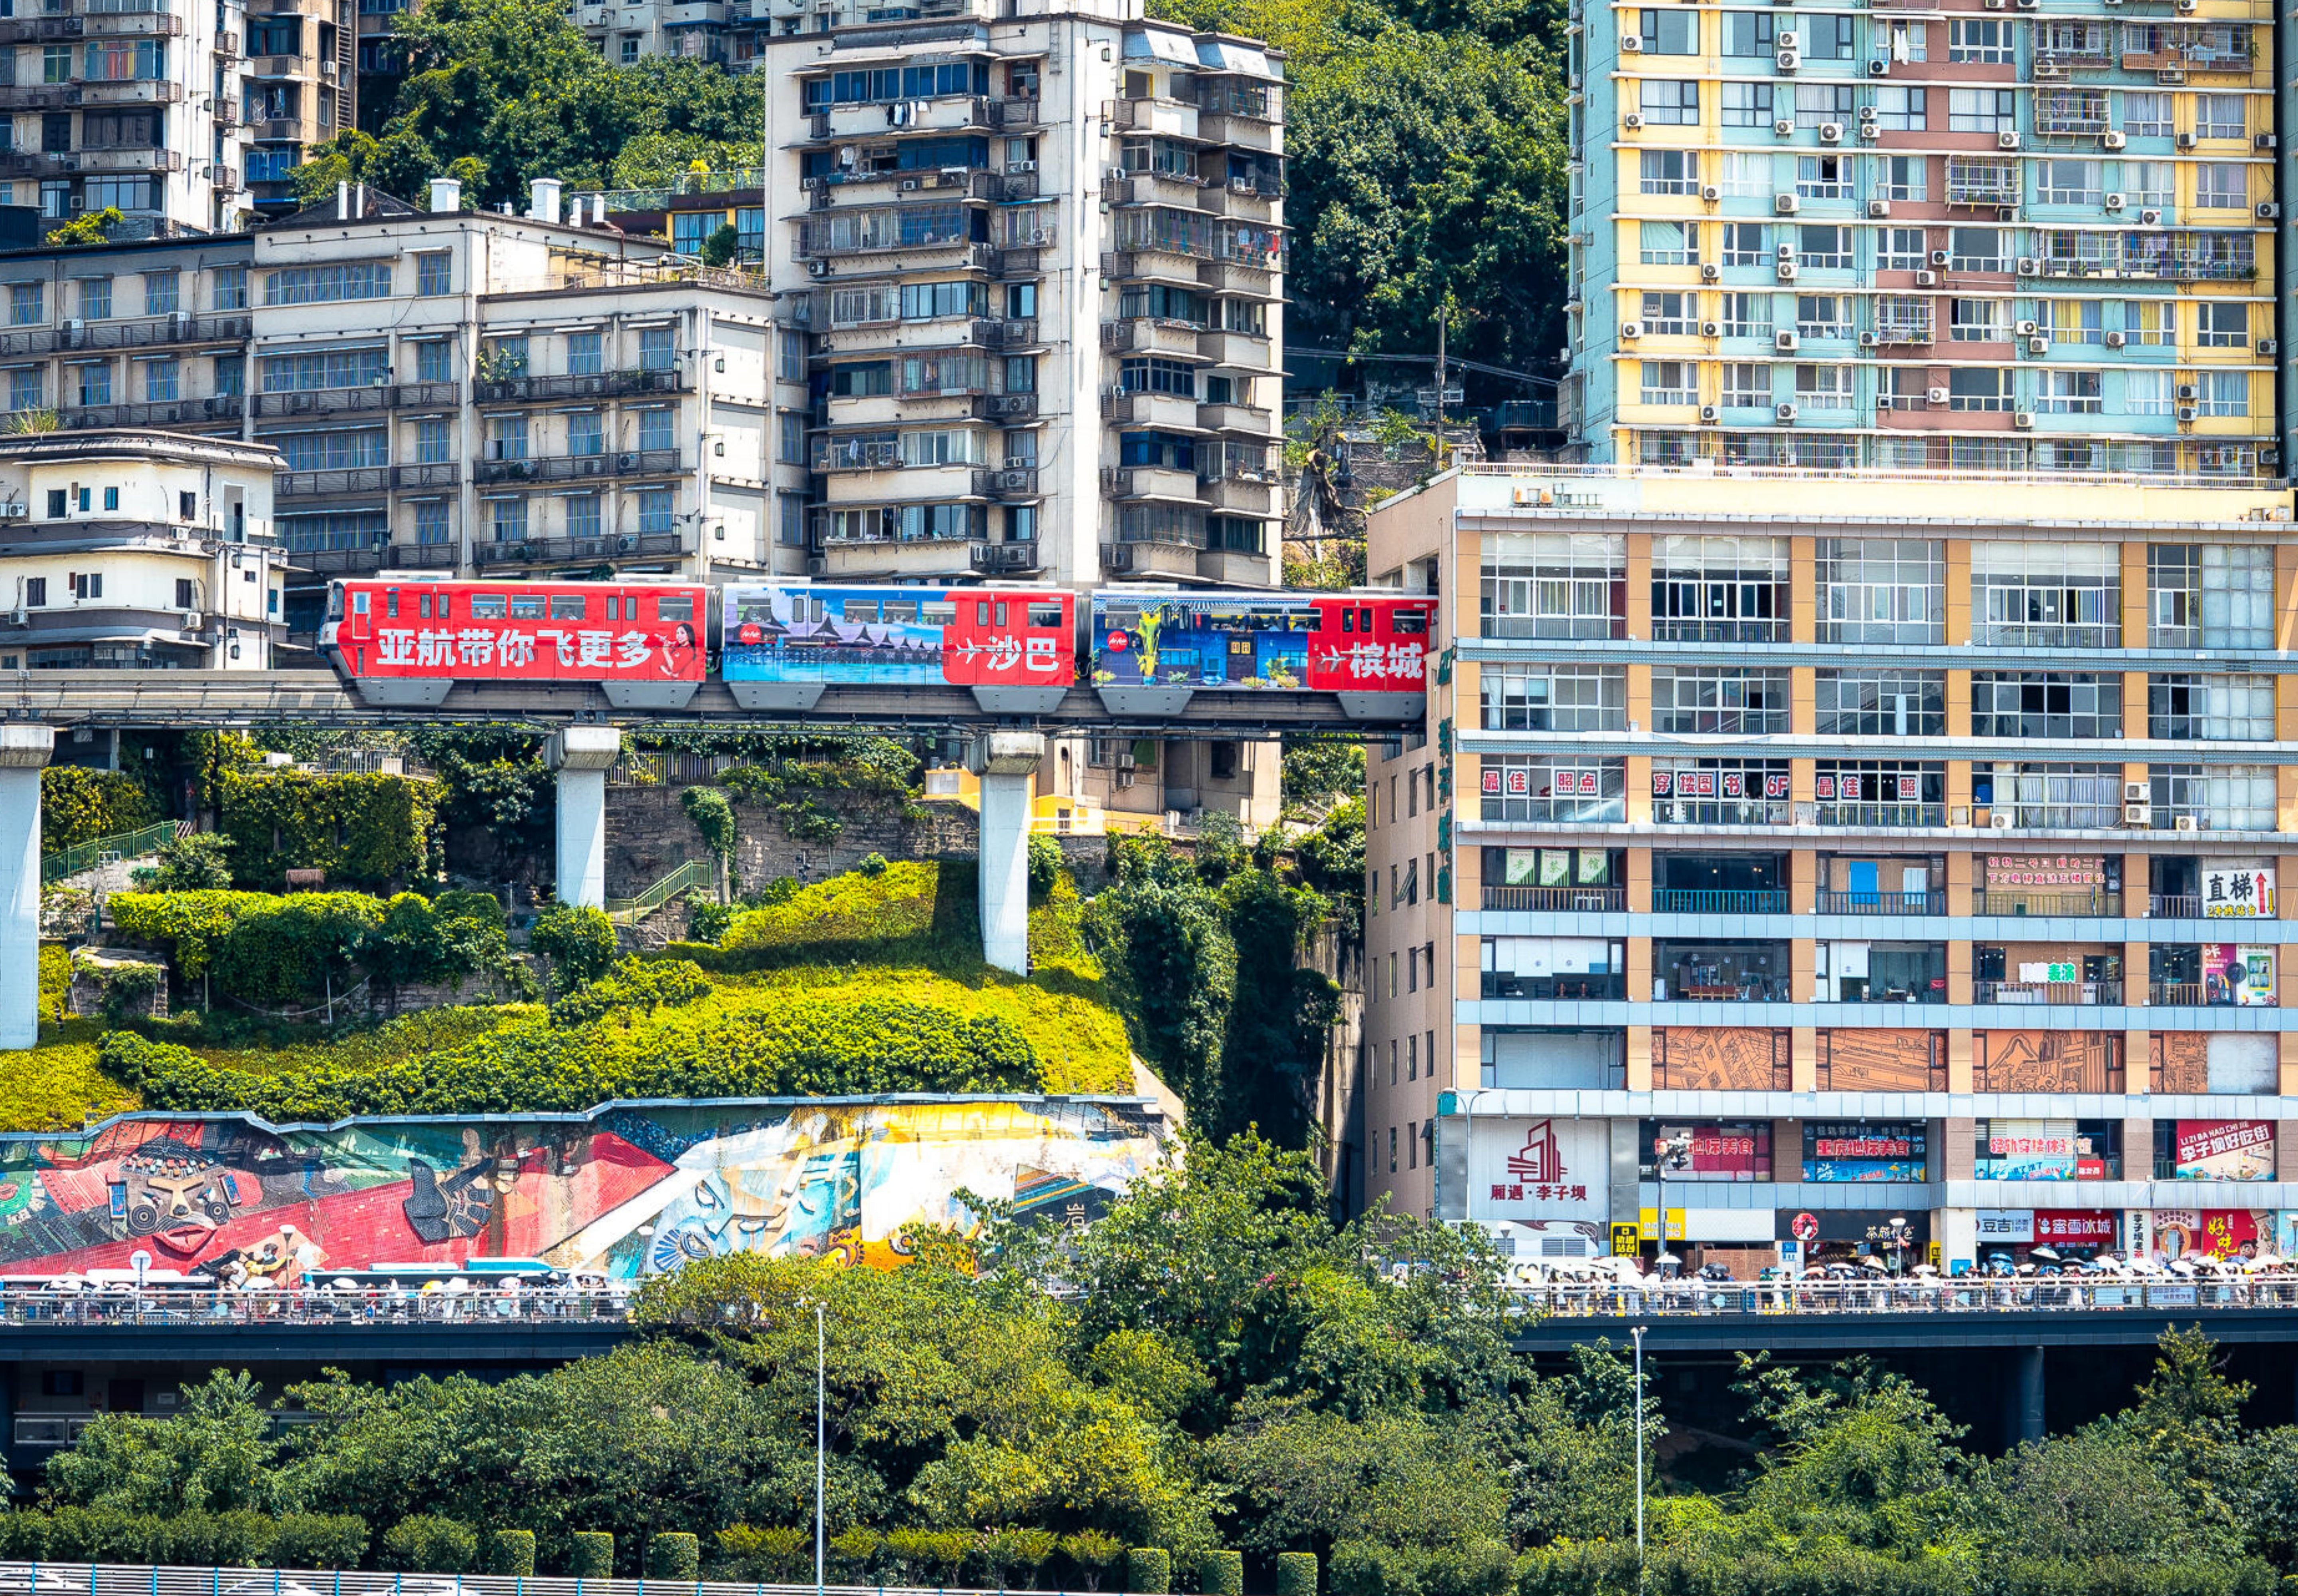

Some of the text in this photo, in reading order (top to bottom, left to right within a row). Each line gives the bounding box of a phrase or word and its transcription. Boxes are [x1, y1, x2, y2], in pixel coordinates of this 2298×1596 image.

[377, 629, 653, 668] 亚航带你飞更多
[986, 635, 1060, 672] 沙巴
[1349, 642, 1423, 679] 槟城
[1483, 770, 1527, 792] 最佳
[1653, 773, 1789, 796] 穿楼图书 6F
[1817, 774, 1860, 798] 最佳
[2206, 872, 2253, 902] 直梯
[2207, 903, 2257, 917] 2号线站台
[2048, 962, 2076, 982] 表演
[1654, 1138, 1754, 1155] 地标美食
[1816, 1139, 1910, 1157] 重庆地标美食
[2180, 1124, 2270, 1162] 李子坝好吃街
[1982, 1218, 2011, 1233] 豆吉
[2052, 1218, 2111, 1234] 蜜雪冰城
